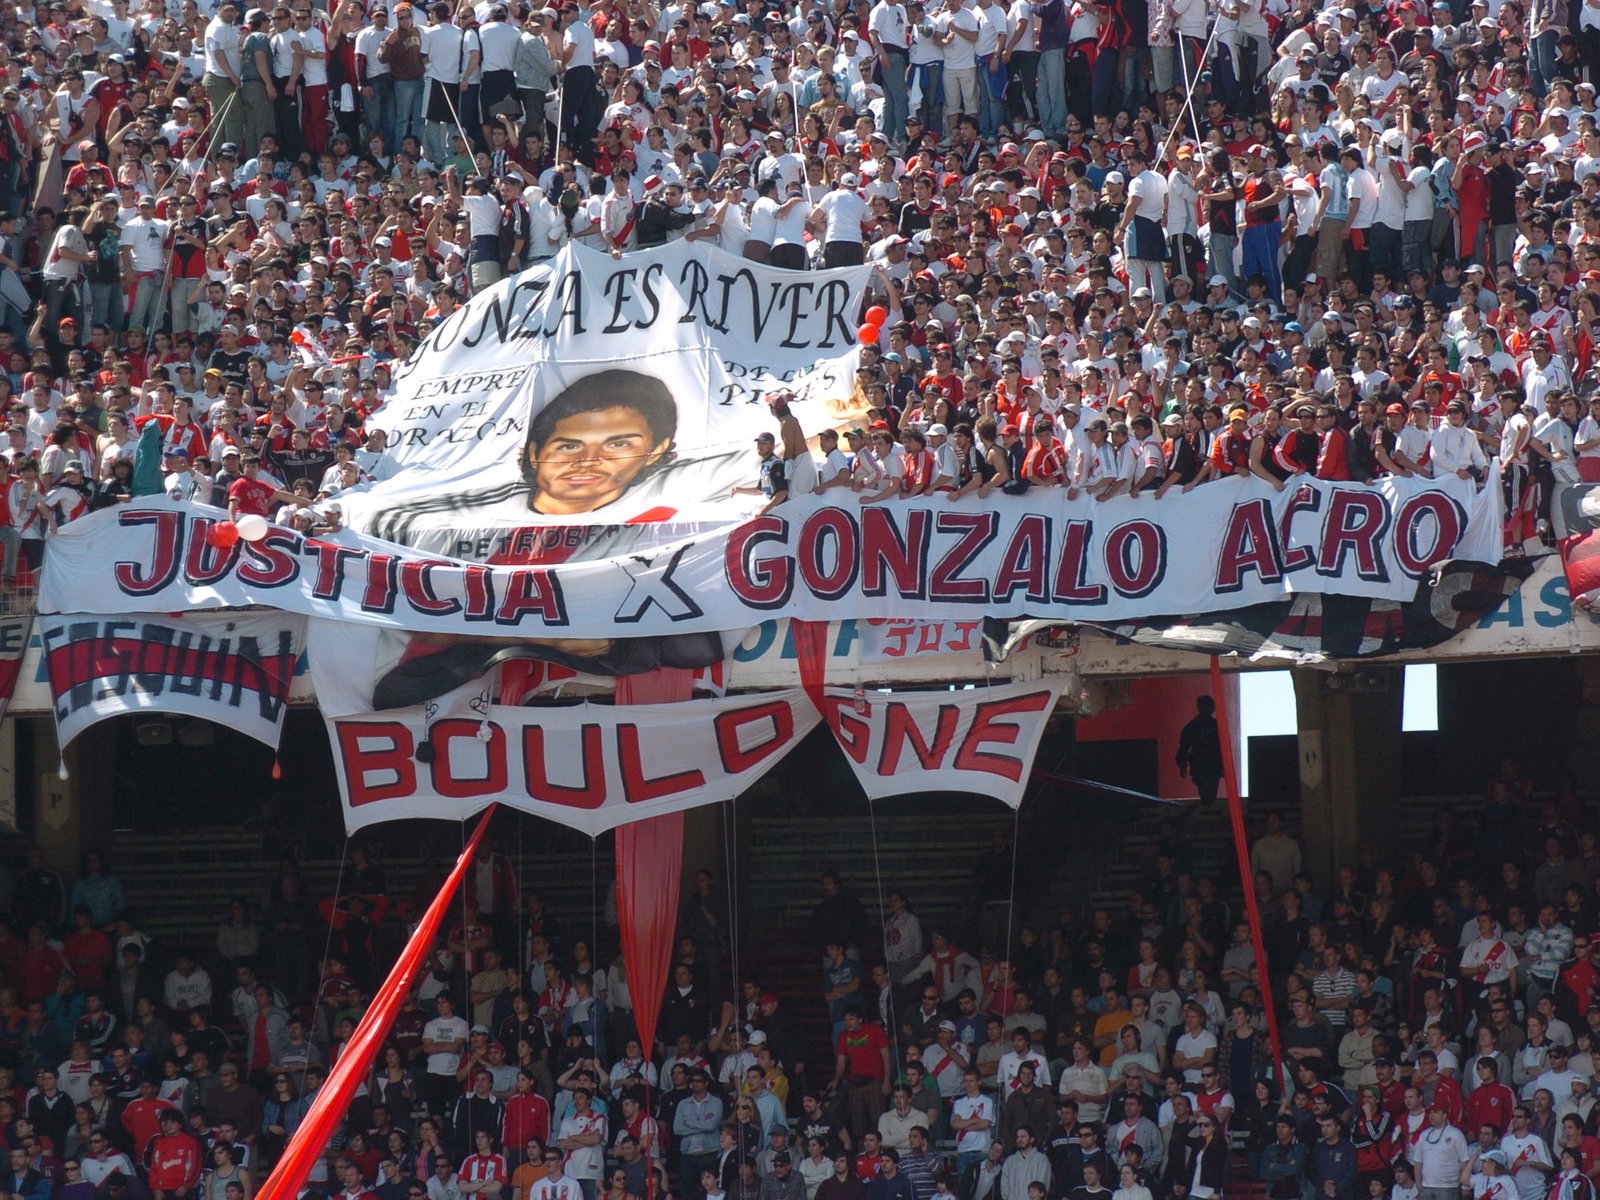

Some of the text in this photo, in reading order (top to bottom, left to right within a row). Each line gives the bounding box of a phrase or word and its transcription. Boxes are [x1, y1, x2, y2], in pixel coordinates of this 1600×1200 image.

[602, 263, 664, 335] ES
[678, 259, 857, 350] RIVER
[403, 402, 450, 421] EN
[723, 360, 770, 382] DE
[115, 483, 1470, 626] JUSTICIA X GONZALO ACRO
[336, 689, 1053, 810] BOULOGNE
